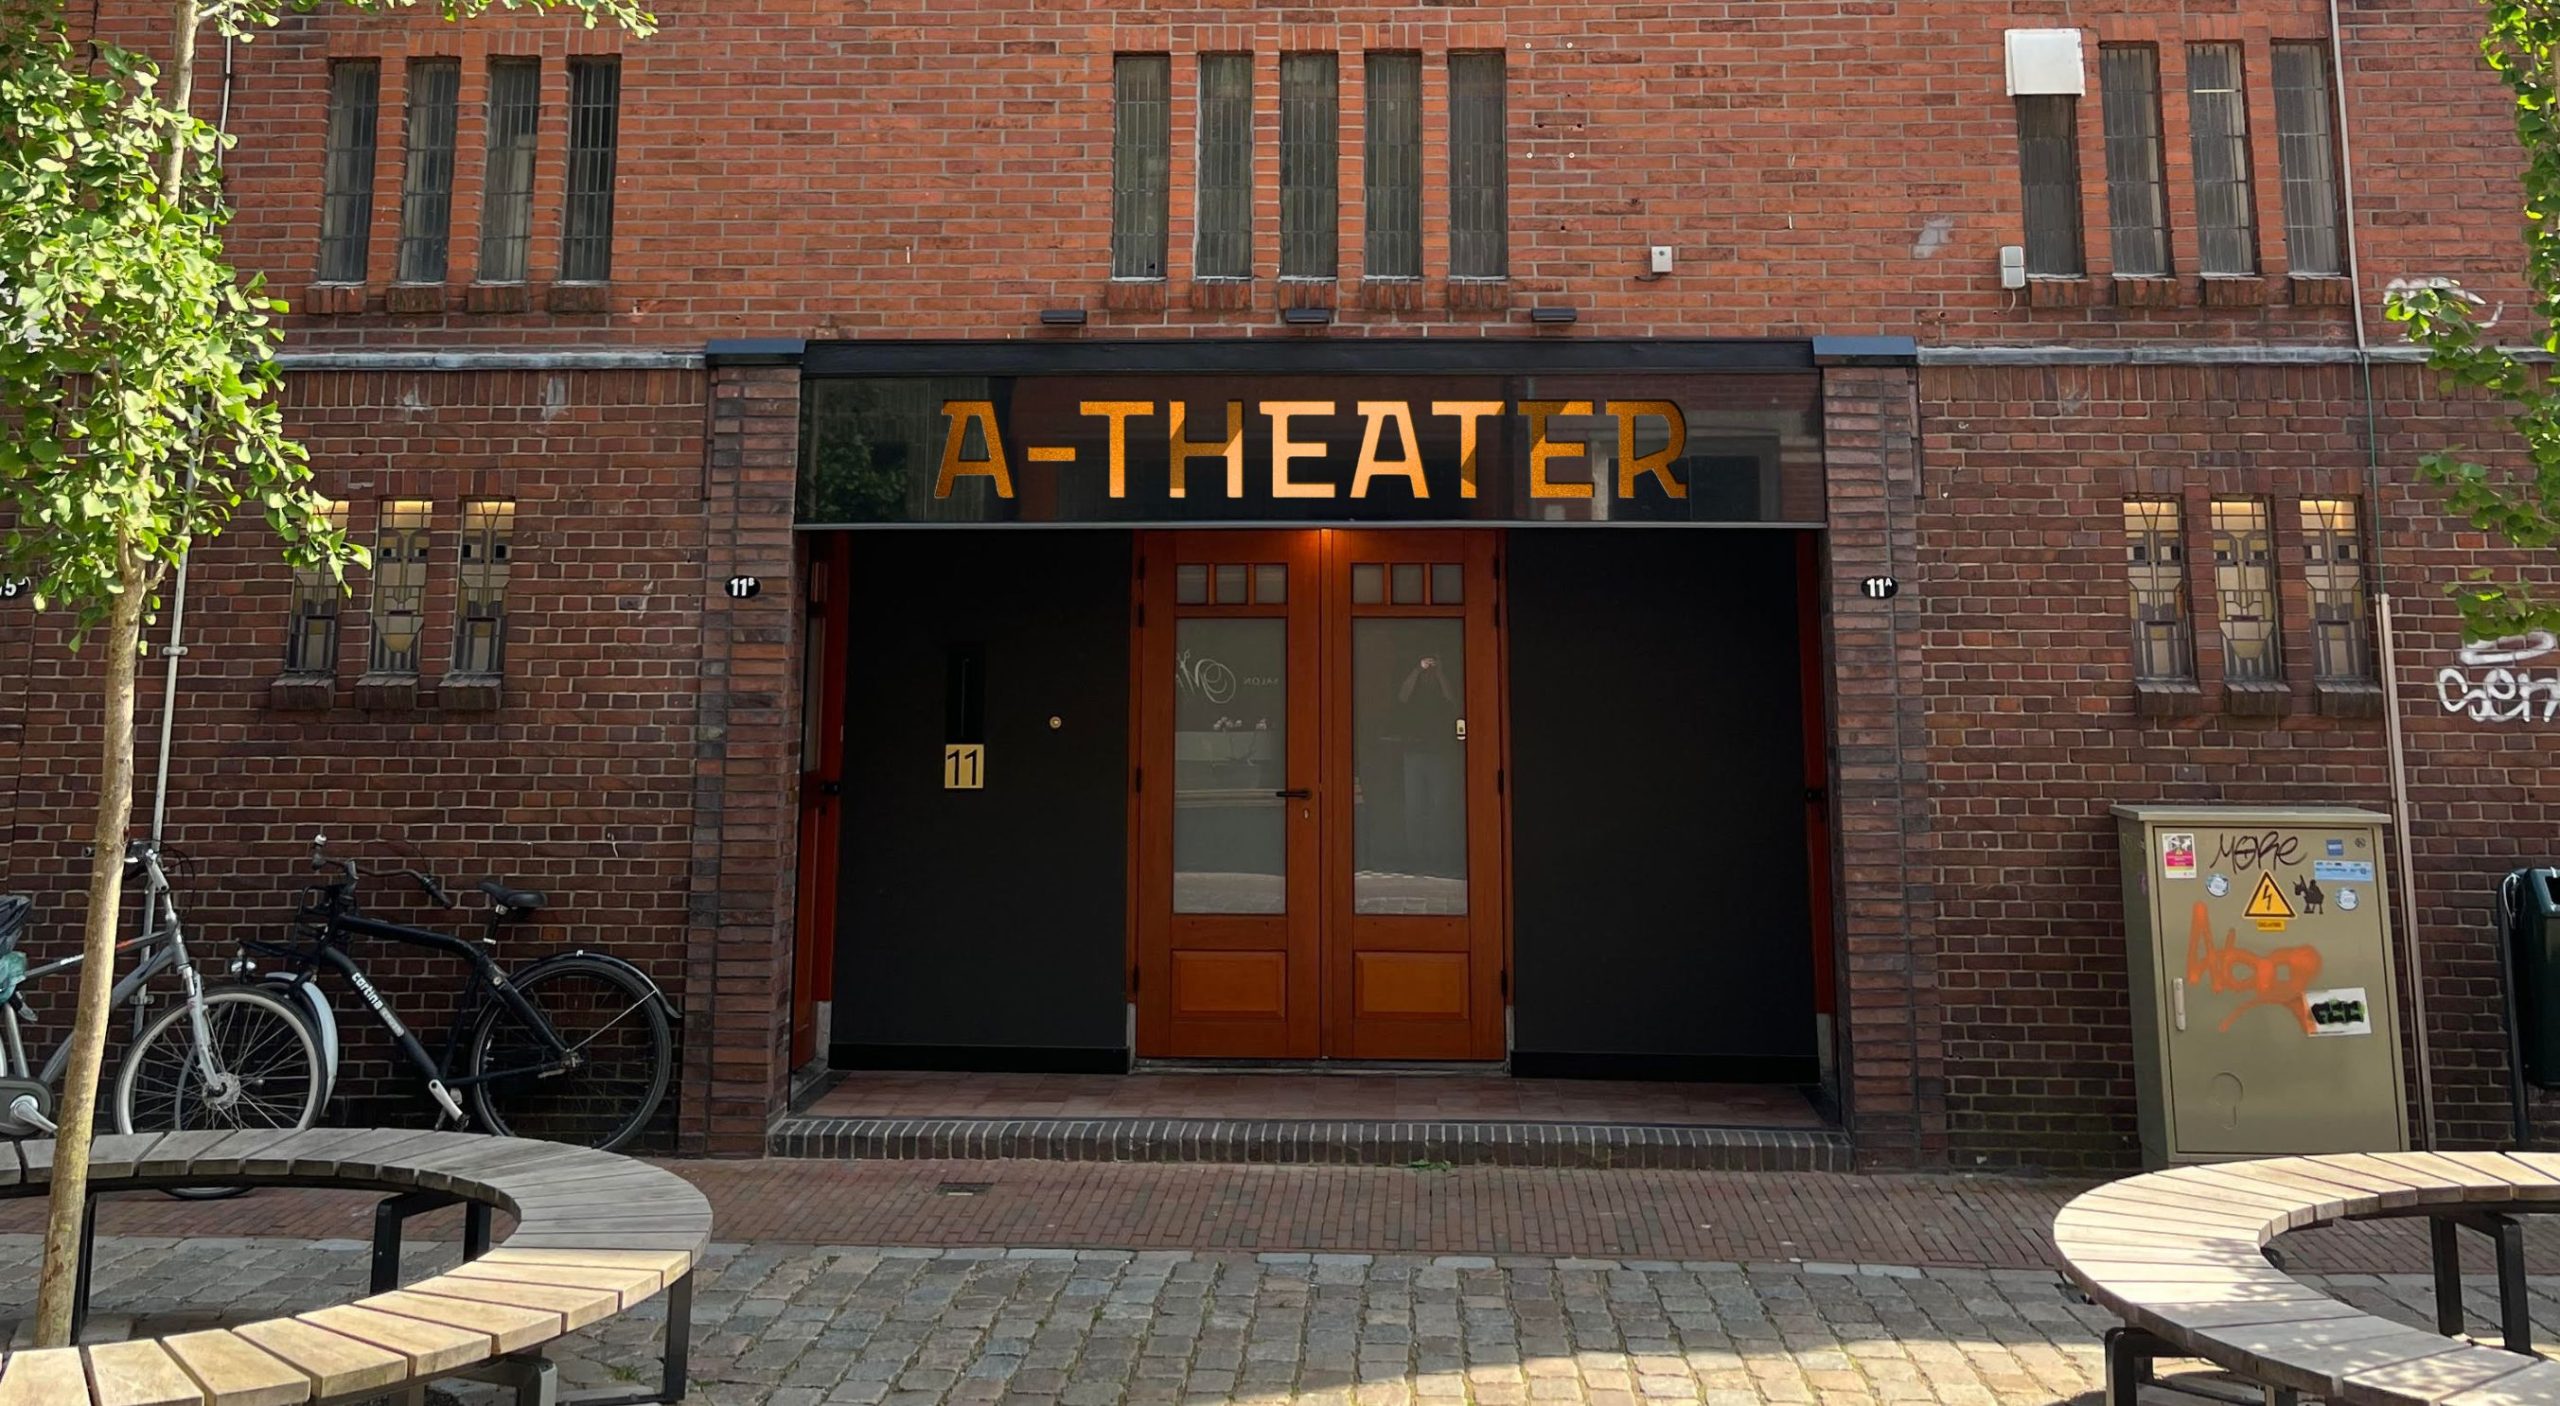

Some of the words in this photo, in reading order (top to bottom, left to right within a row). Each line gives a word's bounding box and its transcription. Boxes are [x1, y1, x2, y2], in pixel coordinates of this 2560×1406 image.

[934, 400, 1688, 498] A-THEATER
[947, 749, 978, 786] 11
[352, 972, 383, 1010] cortina
